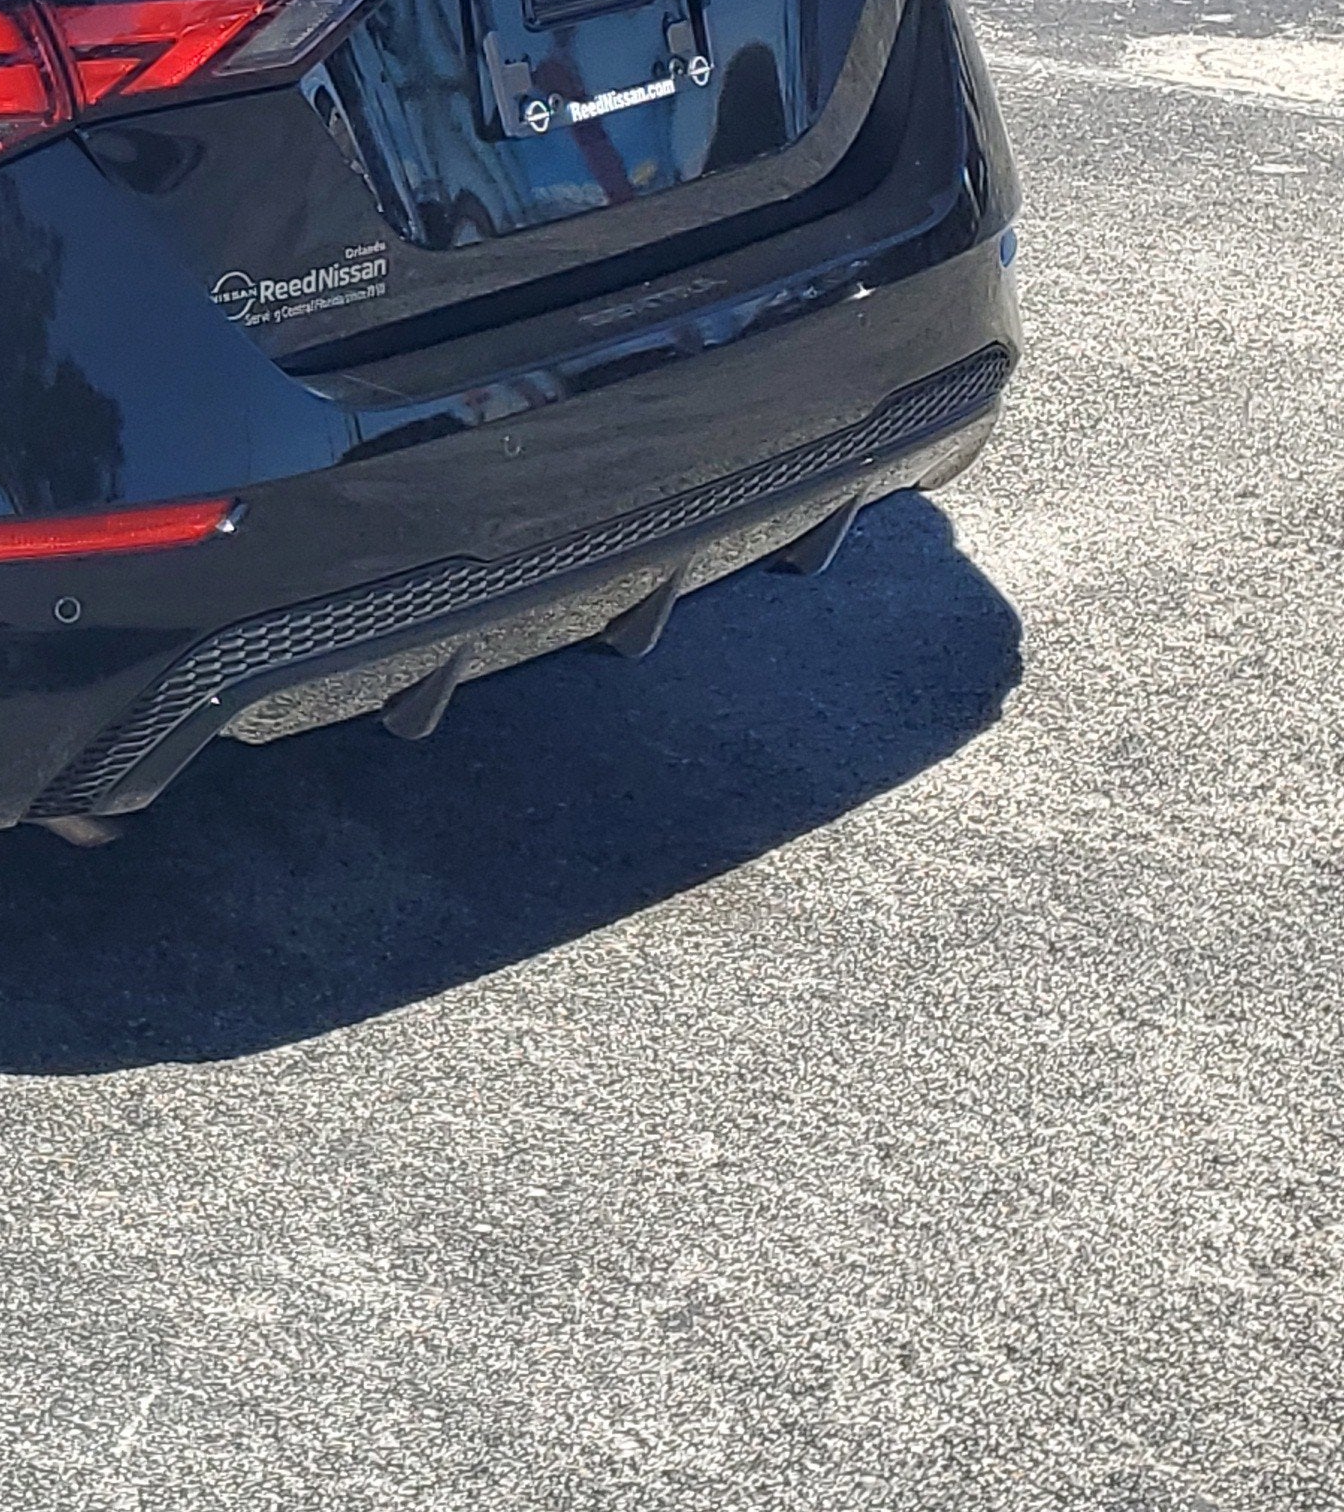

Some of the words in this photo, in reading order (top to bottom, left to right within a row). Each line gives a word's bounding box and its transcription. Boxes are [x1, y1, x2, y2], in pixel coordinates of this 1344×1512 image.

[569, 78, 676, 123] ReedNissan.com
[344, 241, 387, 260] Orlando
[259, 257, 387, 304] ReedNissan
[210, 287, 258, 304] NISSAN
[244, 309, 283, 327] Servig
